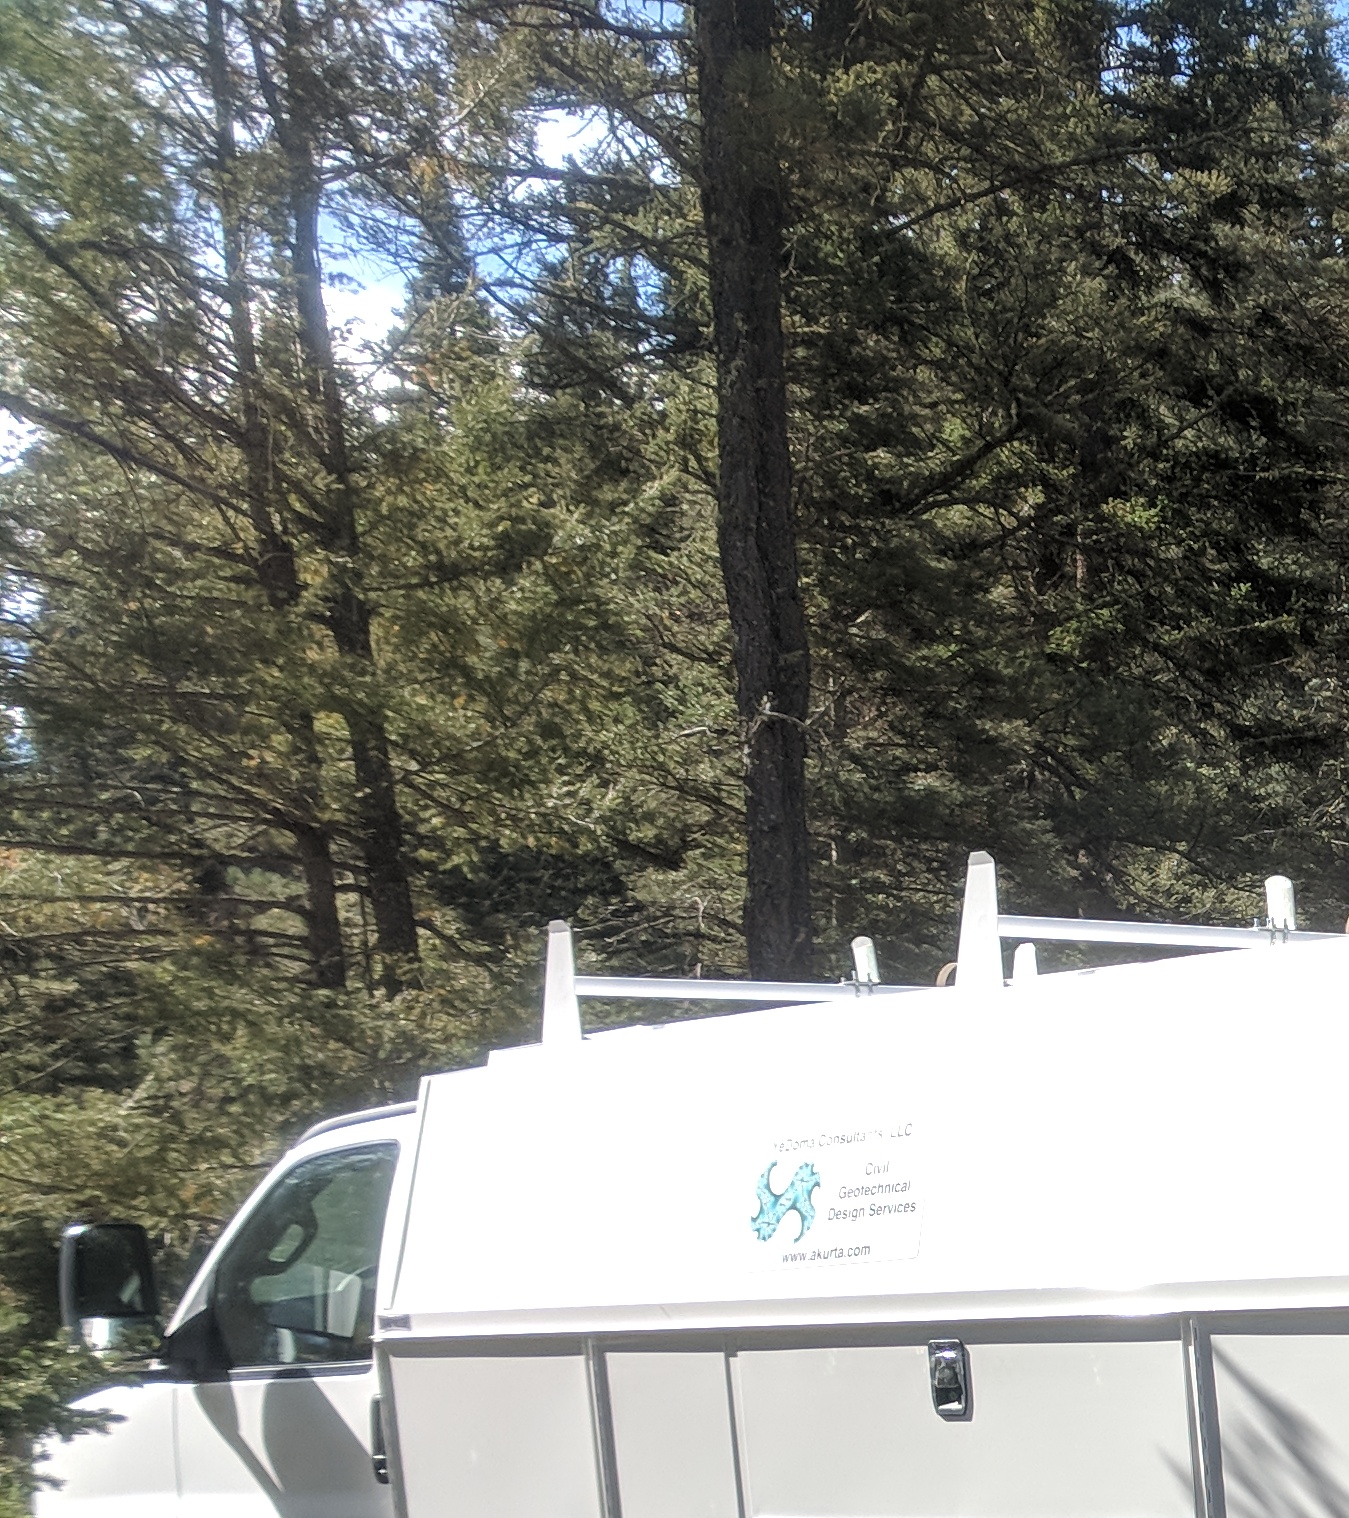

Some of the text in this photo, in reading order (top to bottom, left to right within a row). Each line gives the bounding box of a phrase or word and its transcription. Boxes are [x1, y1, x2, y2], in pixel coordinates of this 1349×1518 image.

[865, 1160, 890, 1175] Civil
[838, 1180, 912, 1199] Geotechnical
[827, 1201, 917, 1221] Design Services
[782, 1244, 872, 1262] www.akurta.com
